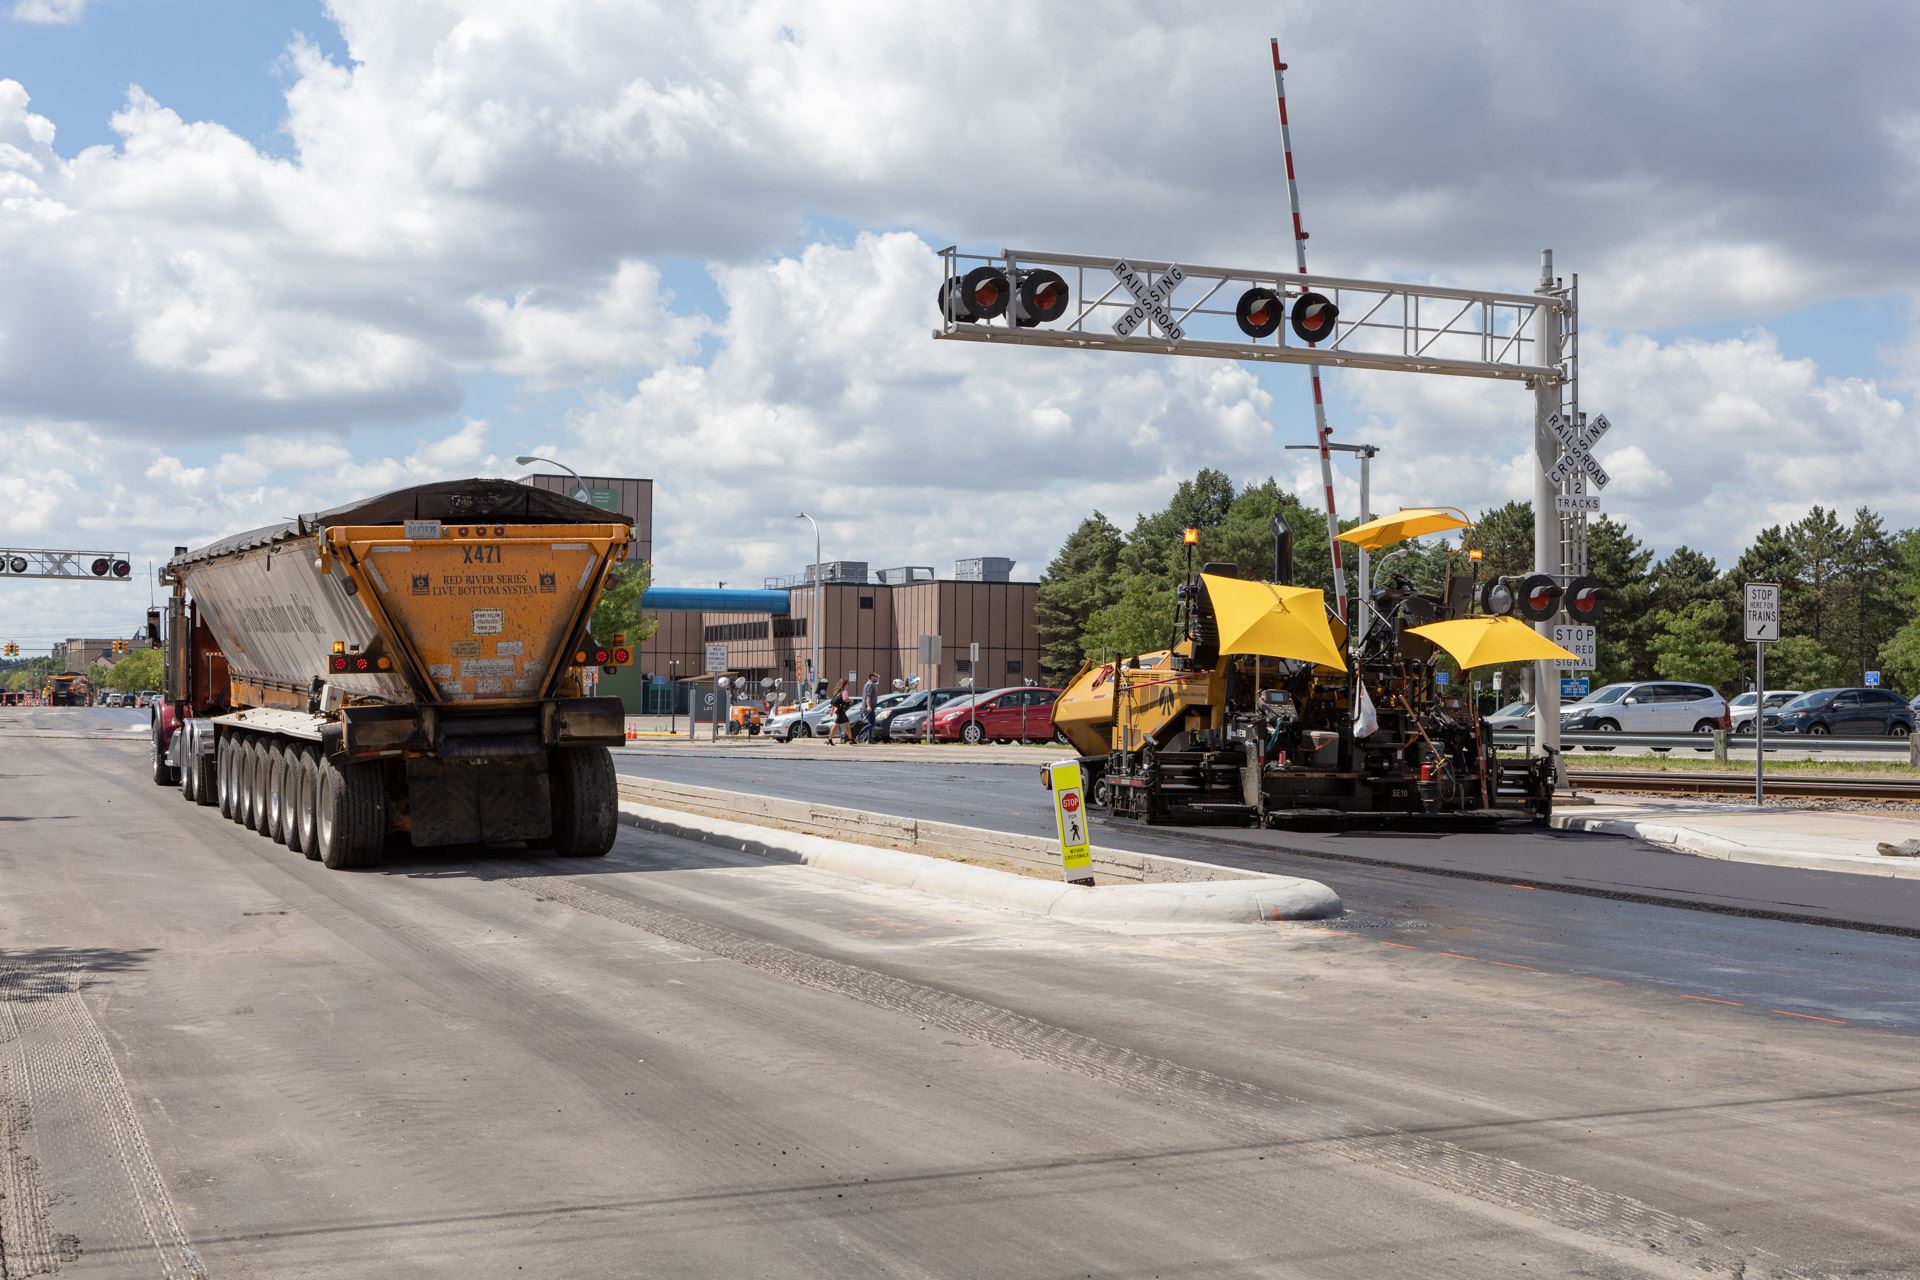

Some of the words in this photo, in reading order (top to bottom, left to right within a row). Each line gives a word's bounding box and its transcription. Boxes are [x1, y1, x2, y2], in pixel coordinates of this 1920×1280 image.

[1117, 268, 1182, 336] CROSSING
[1551, 418, 1607, 483] CROSSING
[1574, 482, 1582, 494] 2
[1558, 498, 1598, 508] TRACKS
[462, 543, 501, 564] X471
[443, 576, 462, 584] RED
[465, 575, 494, 584] RIVER
[497, 574, 527, 584] SERIES
[433, 587, 456, 596] LIVE
[458, 586, 499, 596] BOTTOM
[503, 585, 538, 595] SYSTEM
[1752, 589, 1773, 600] STOP
[1748, 610, 1776, 622] TRAINS
[1556, 629, 1594, 641] STOP
[1575, 645, 1594, 654] RED
[1555, 659, 1594, 667] SIGNAL
[1391, 789, 1409, 798] SE10
[1063, 797, 1078, 808] STOP
